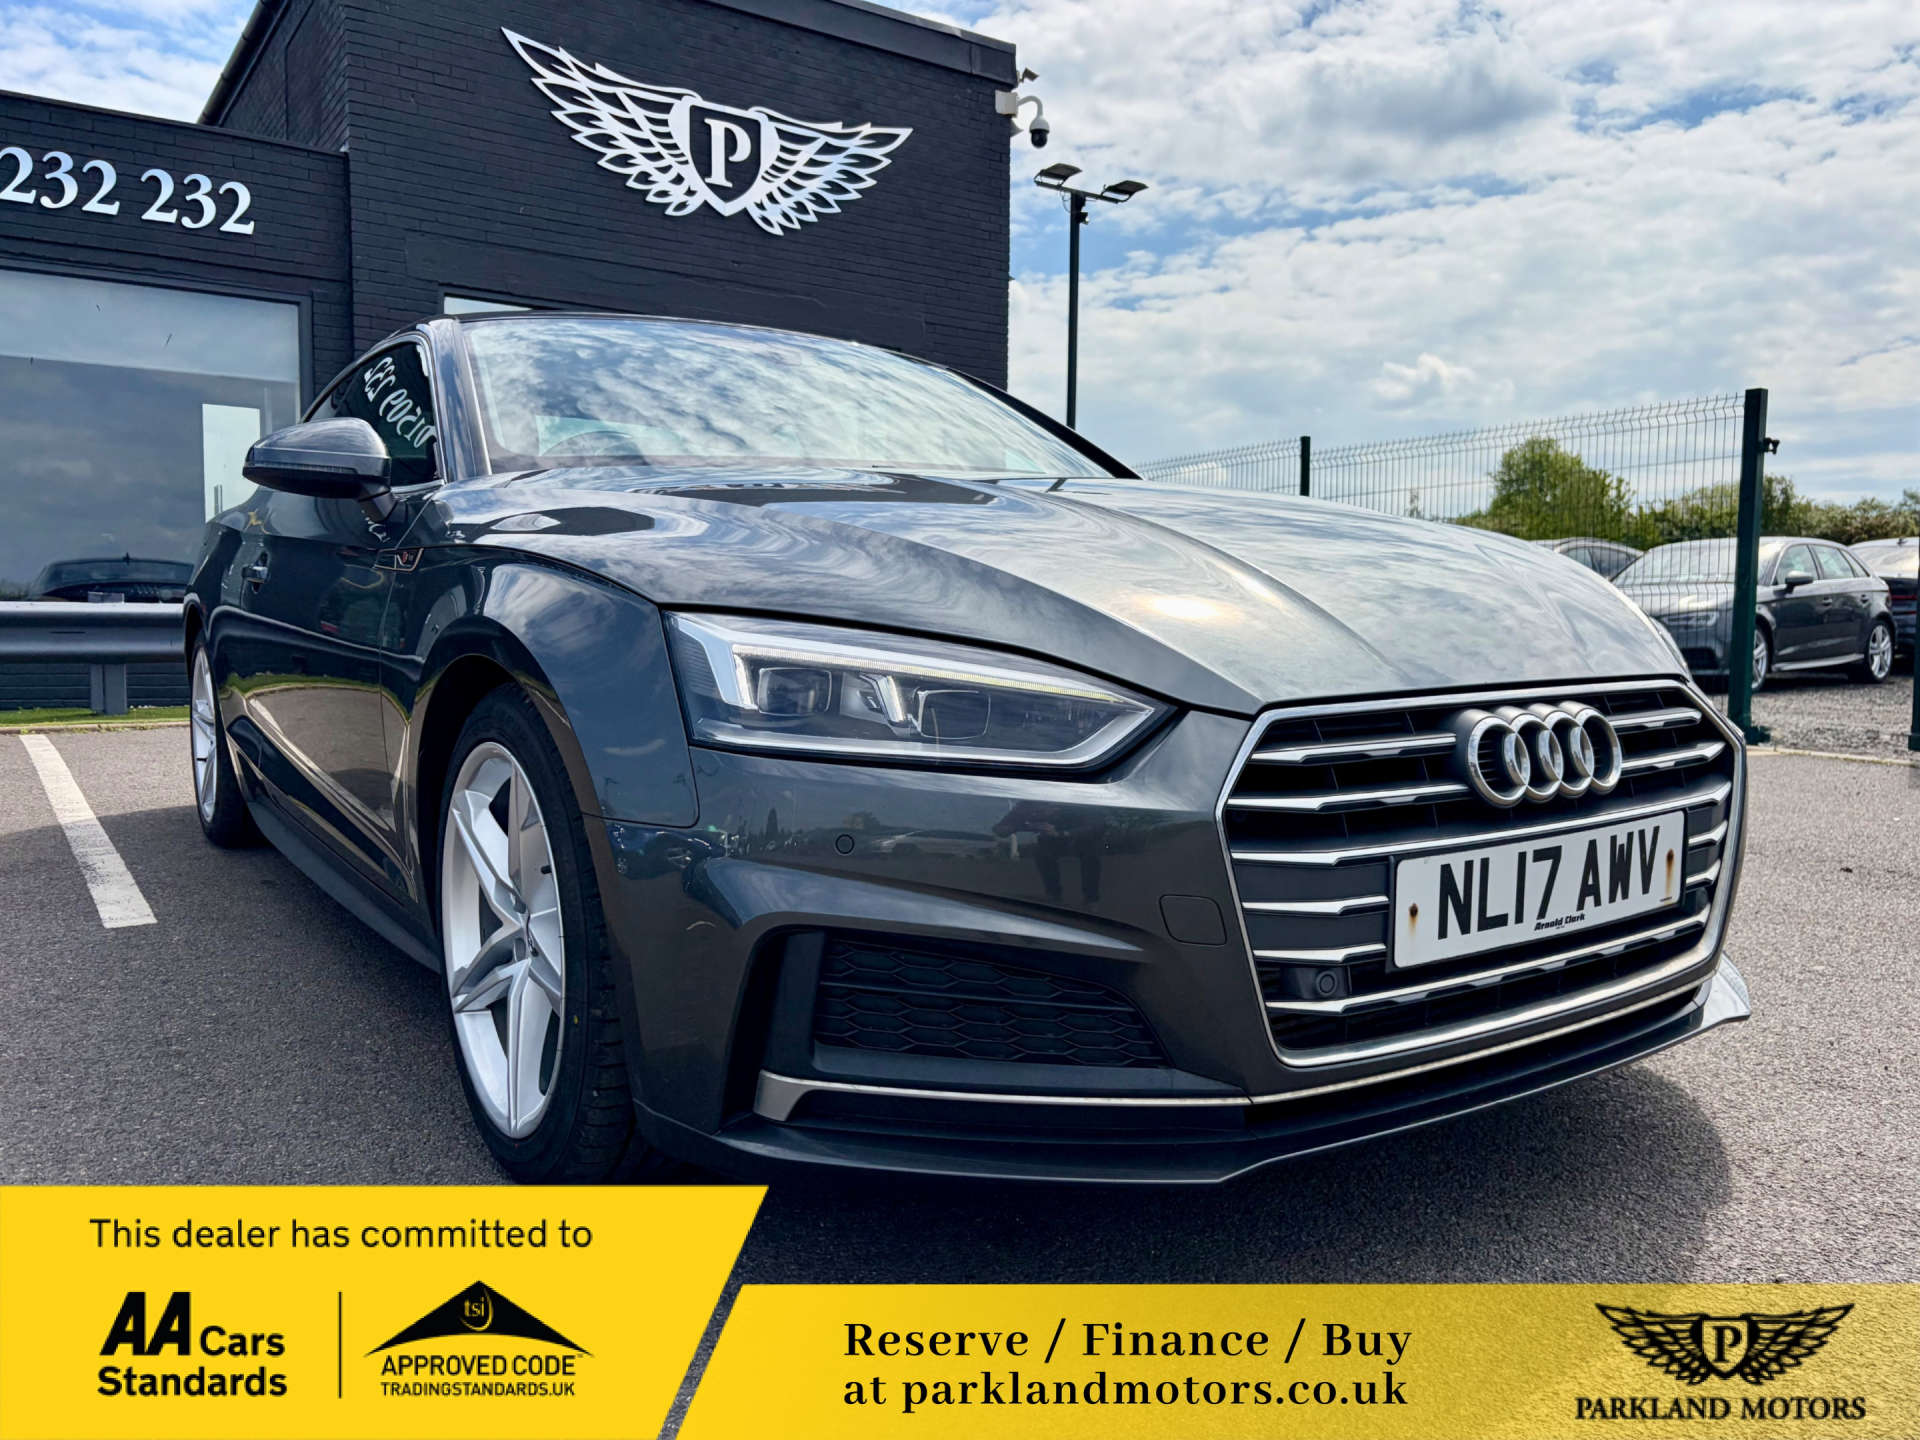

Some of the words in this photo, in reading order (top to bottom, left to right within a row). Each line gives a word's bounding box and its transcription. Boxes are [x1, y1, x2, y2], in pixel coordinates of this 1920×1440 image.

[0, 147, 120, 215] 232
[140, 168, 255, 235] 232
[704, 118, 751, 188] P
[1437, 845, 1563, 940] NL17
[1576, 825, 1660, 912] AWV
[1534, 917, 1564, 931] Arnold
[1564, 913, 1586, 925] Clark
